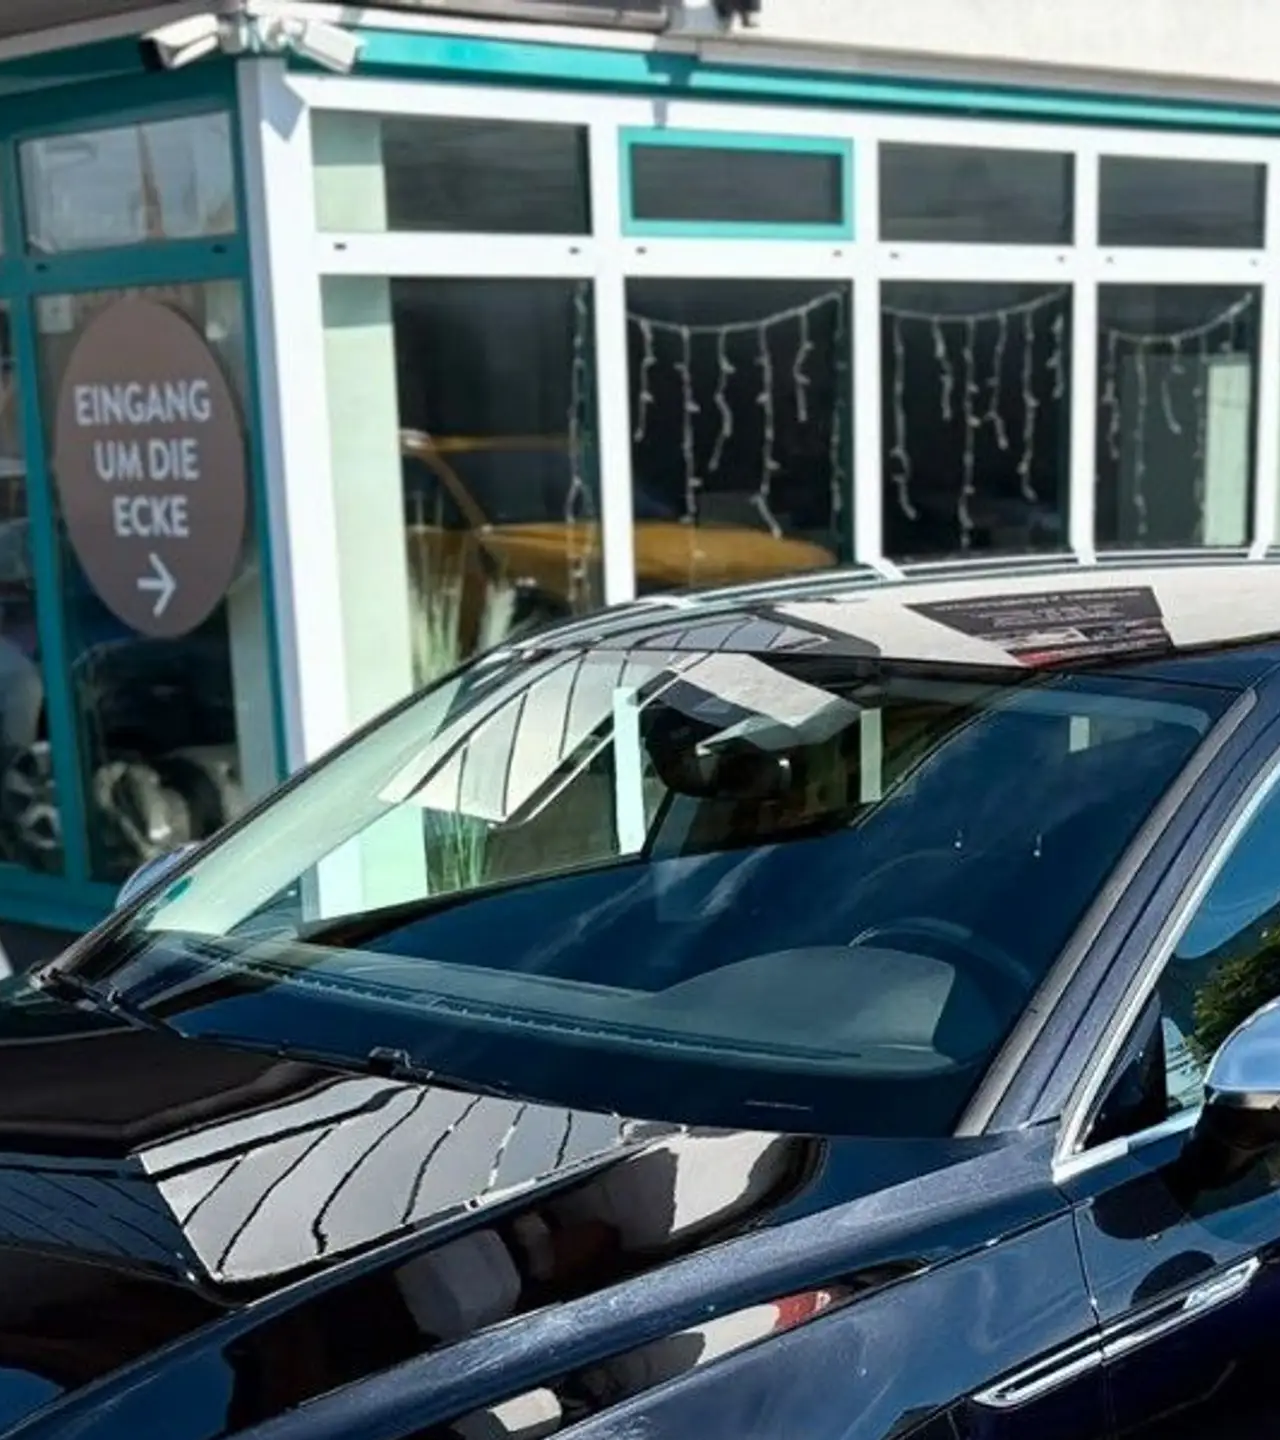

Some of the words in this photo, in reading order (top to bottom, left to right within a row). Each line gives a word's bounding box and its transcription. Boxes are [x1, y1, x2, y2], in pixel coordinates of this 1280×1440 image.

[74, 379, 212, 426] EINGANG
[93, 438, 145, 482] UM
[147, 437, 200, 481] DIE
[112, 494, 191, 538] ECKE
